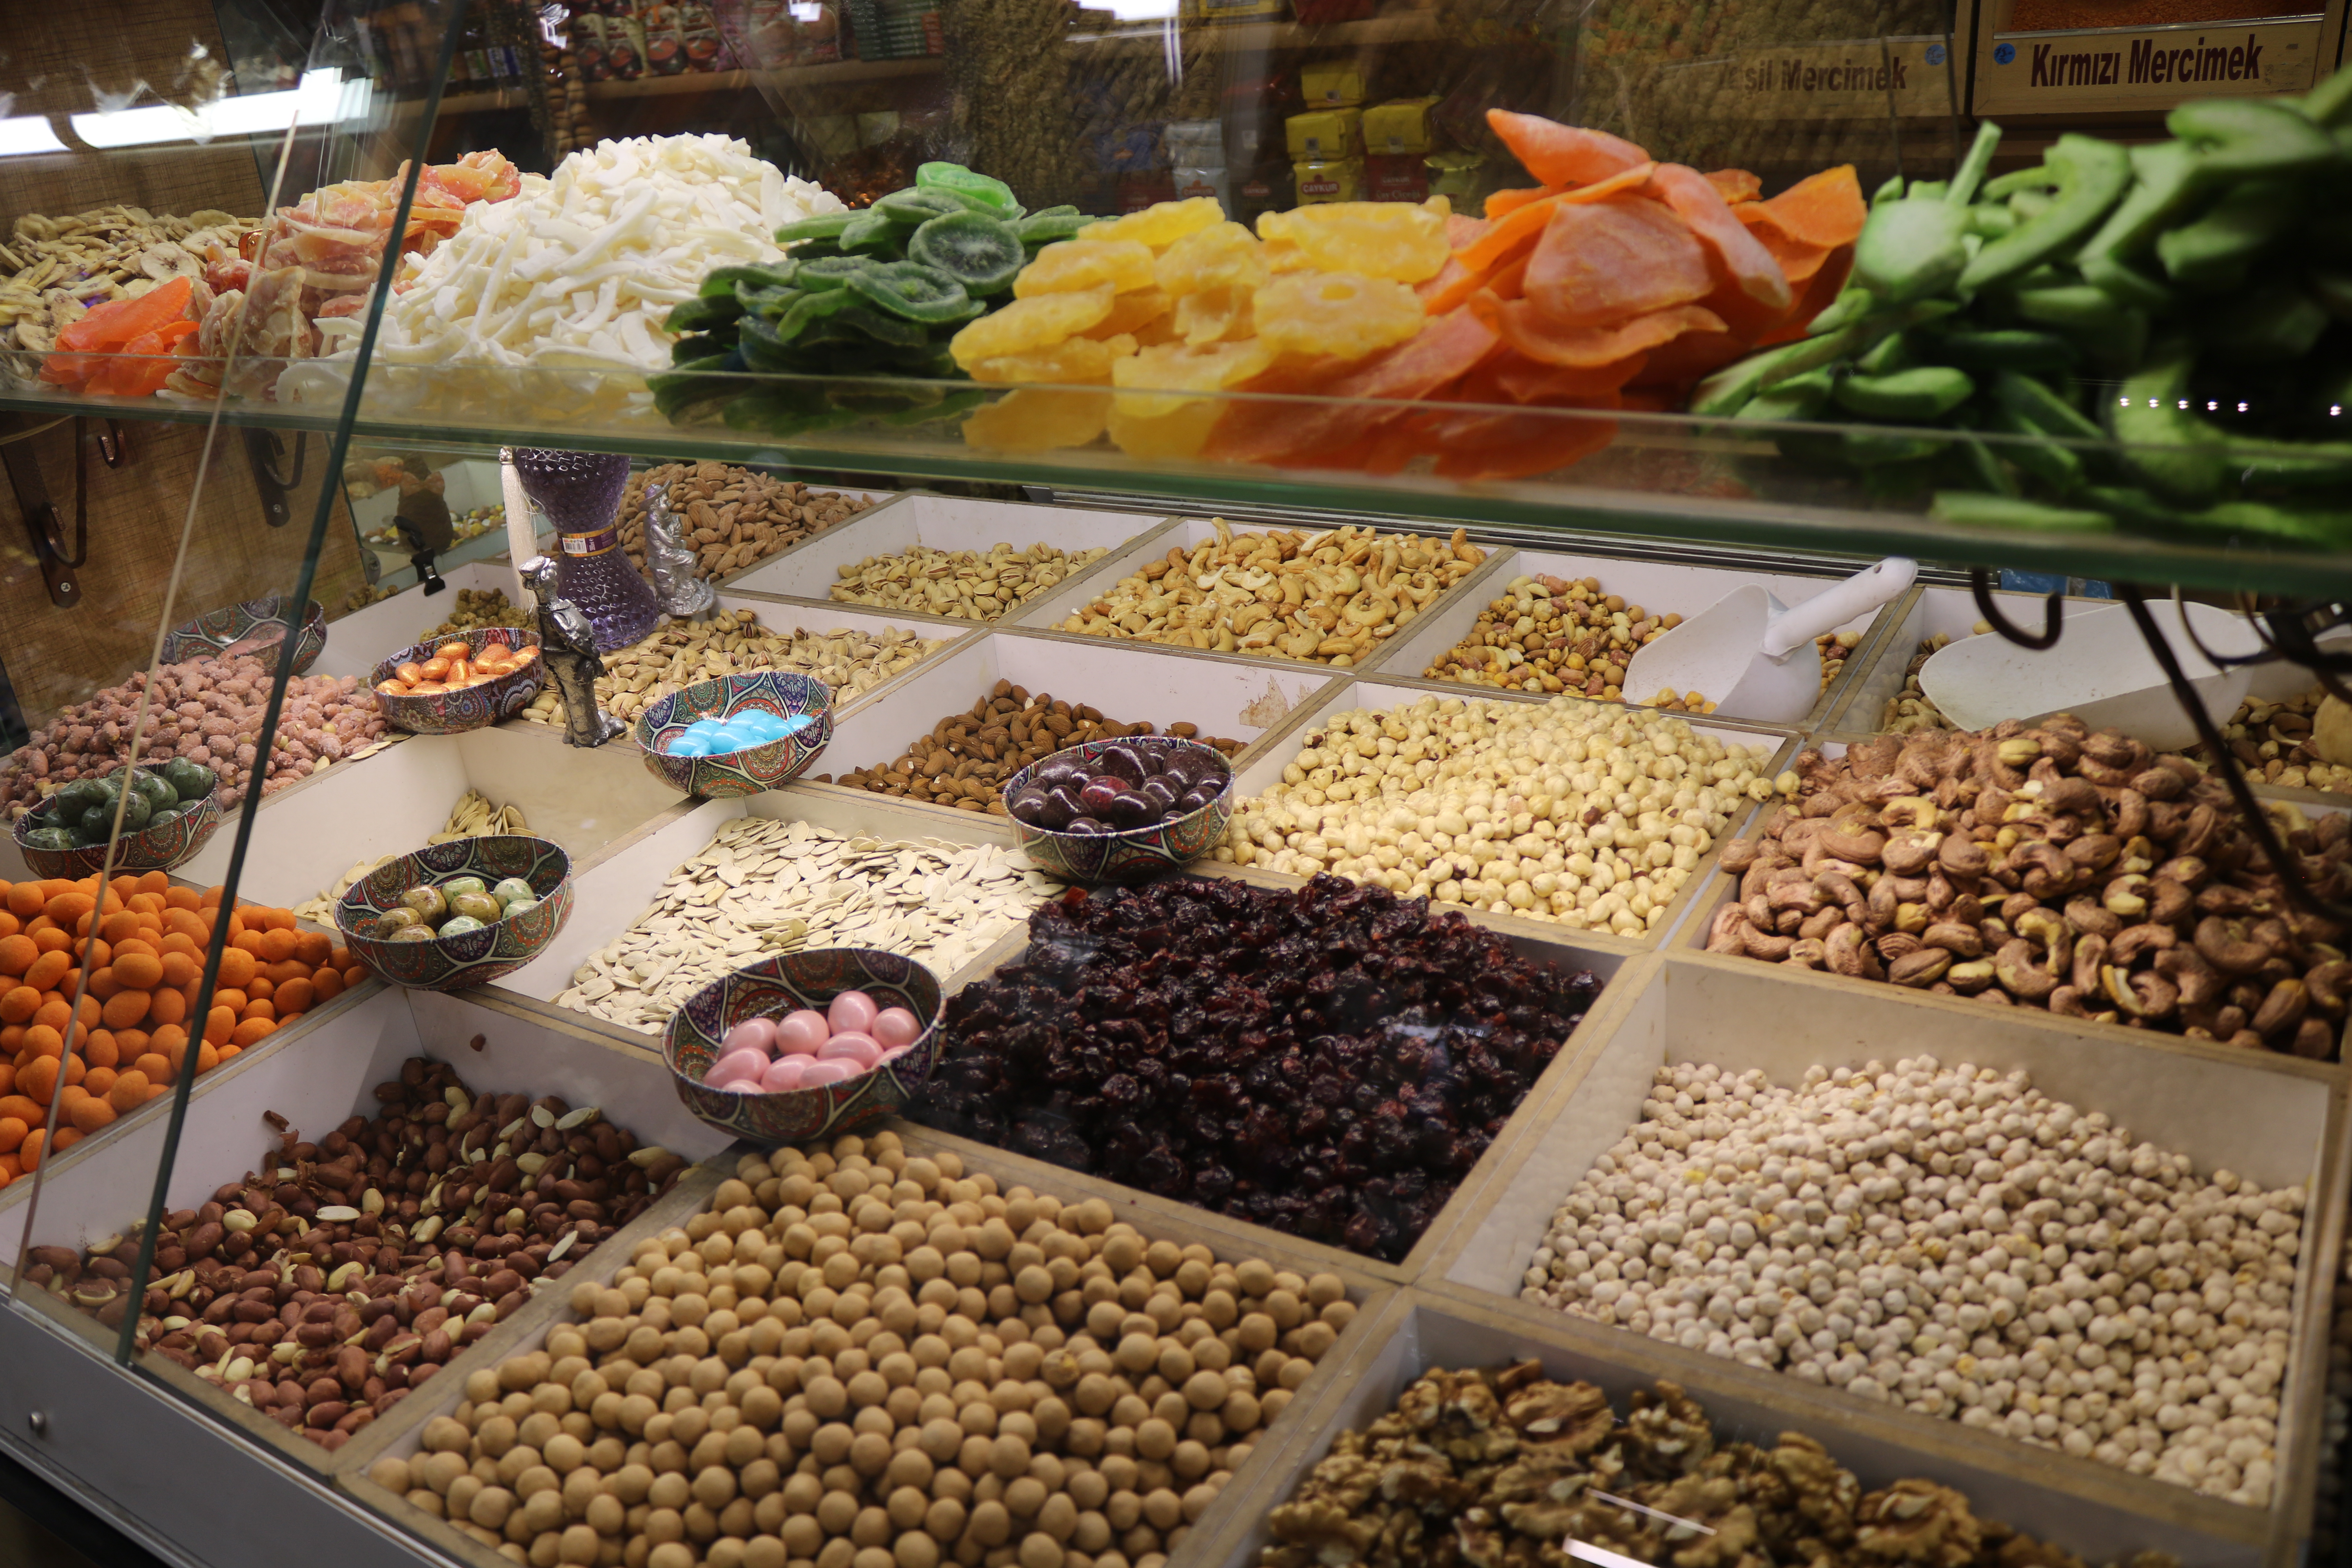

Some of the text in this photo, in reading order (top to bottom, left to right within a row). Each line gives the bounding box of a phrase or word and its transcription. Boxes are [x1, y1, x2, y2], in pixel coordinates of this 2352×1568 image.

[1781, 57, 1908, 91] Mercimek
[2031, 34, 2263, 87] Kırmızı Mercimek
